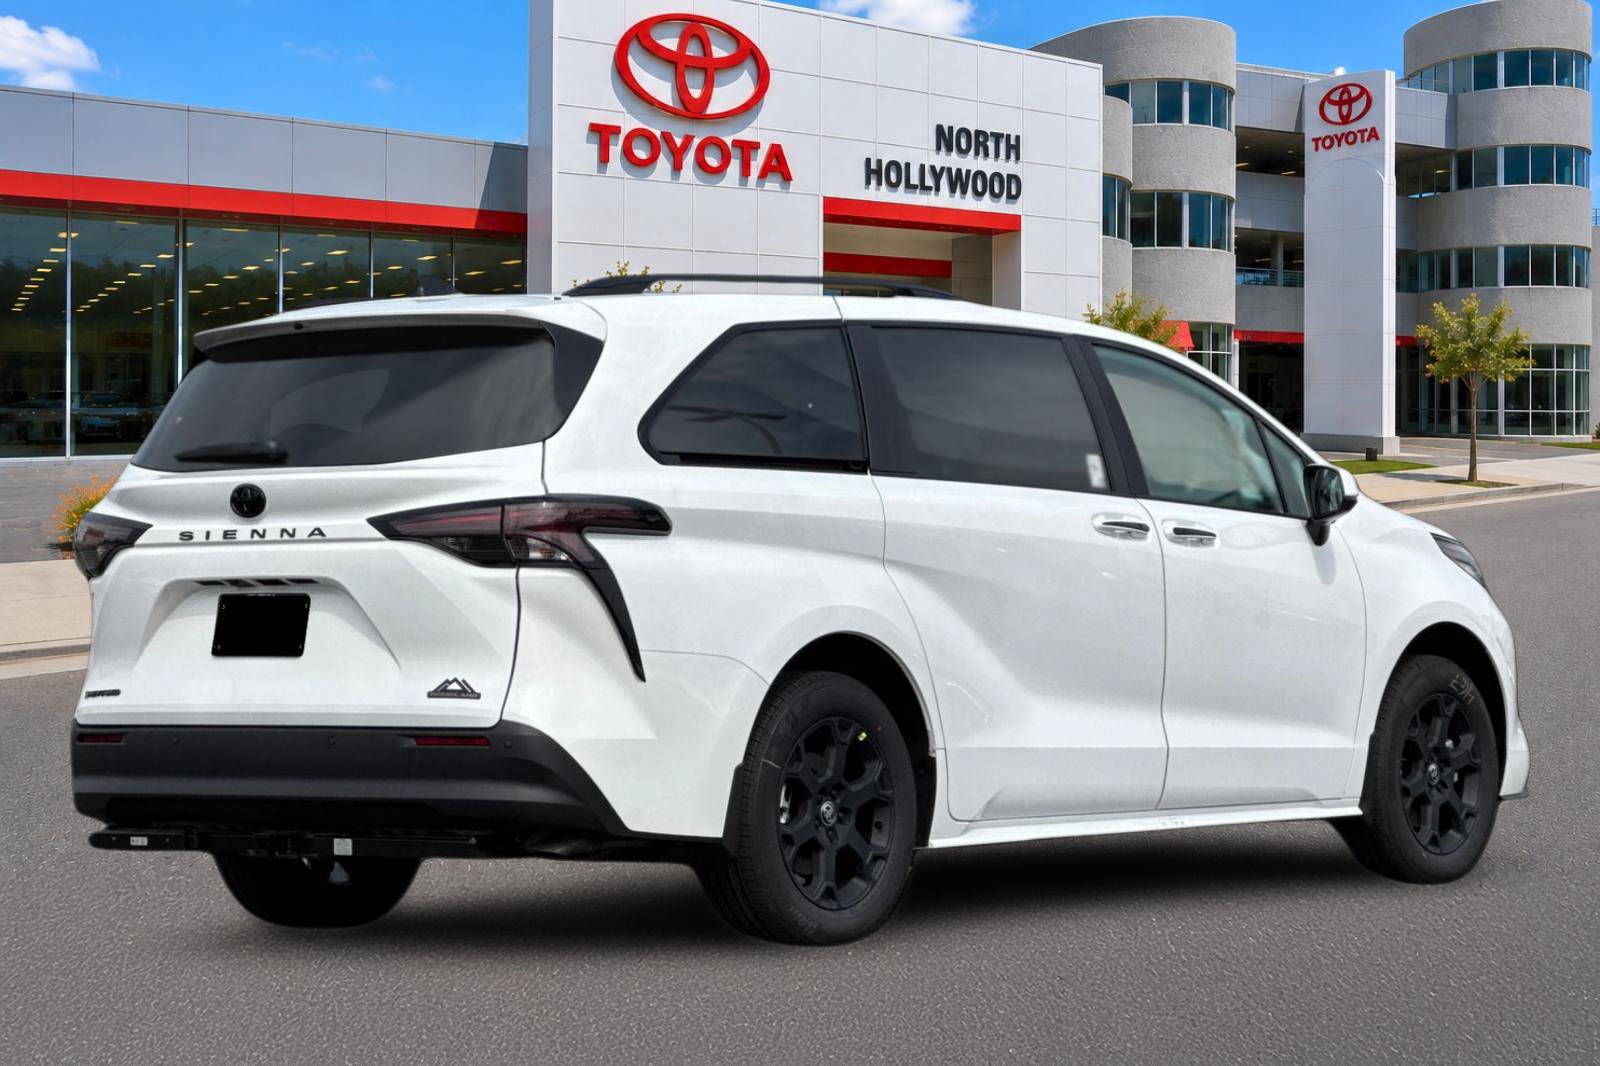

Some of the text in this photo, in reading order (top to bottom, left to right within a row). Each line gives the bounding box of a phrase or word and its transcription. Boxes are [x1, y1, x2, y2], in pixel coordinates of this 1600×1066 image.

[589, 122, 793, 181] TOYOTA
[935, 123, 1021, 161] NORTH
[1312, 126, 1380, 152] TOYOTA
[865, 157, 1022, 200] HOLLYWOOD
[178, 527, 326, 542] SIENNA
